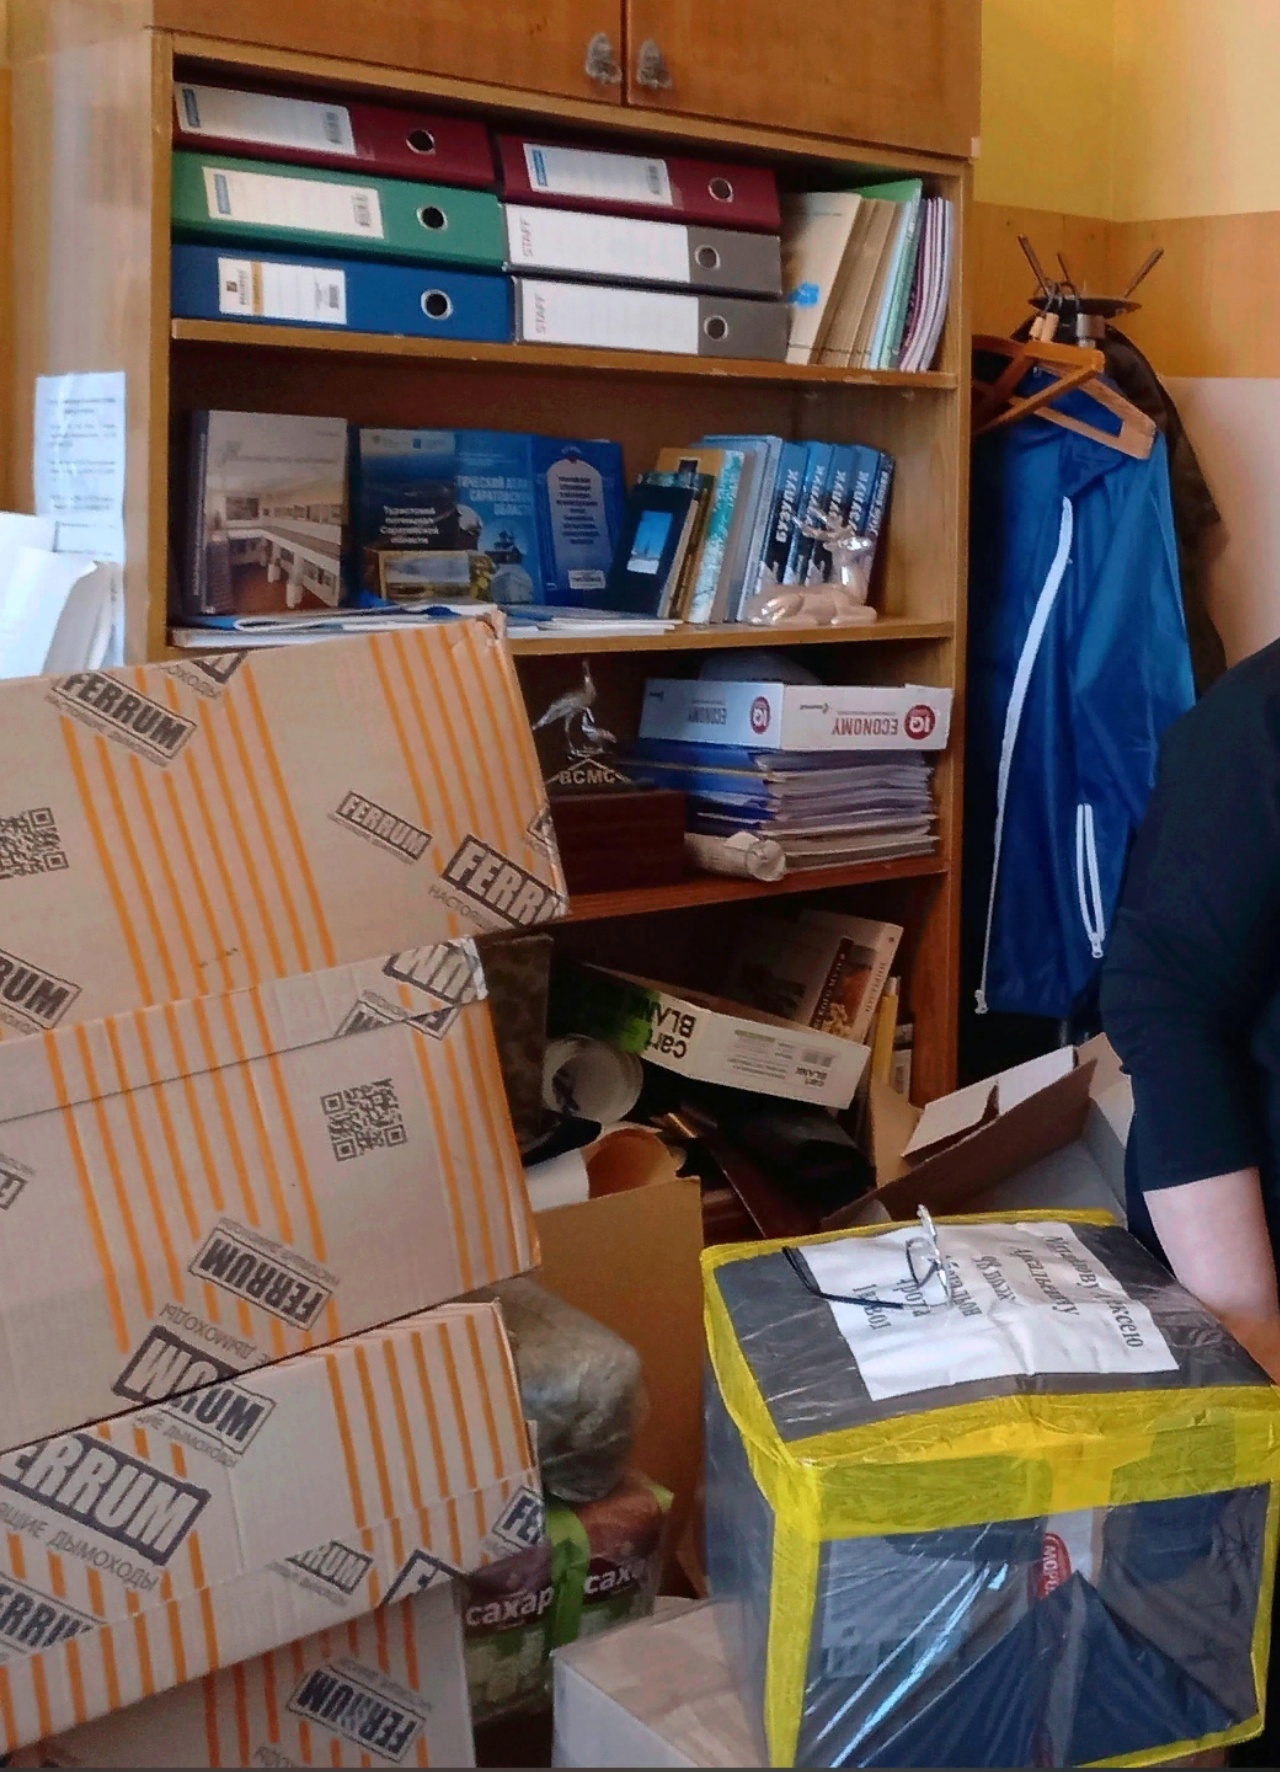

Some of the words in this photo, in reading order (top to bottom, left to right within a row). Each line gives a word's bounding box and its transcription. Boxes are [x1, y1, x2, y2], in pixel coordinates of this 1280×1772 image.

[521, 217, 534, 258] STAFF
[534, 292, 547, 335] STAFF
[63, 672, 190, 749] FERRUM
[831, 718, 898, 735] ECONOMY
[341, 795, 430, 859] FERRUM
[202, 1237, 331, 1326] FERRUM
[49, 1528, 158, 1590] ДЫМОХОДЫ
[465, 1586, 554, 1626] сахар
